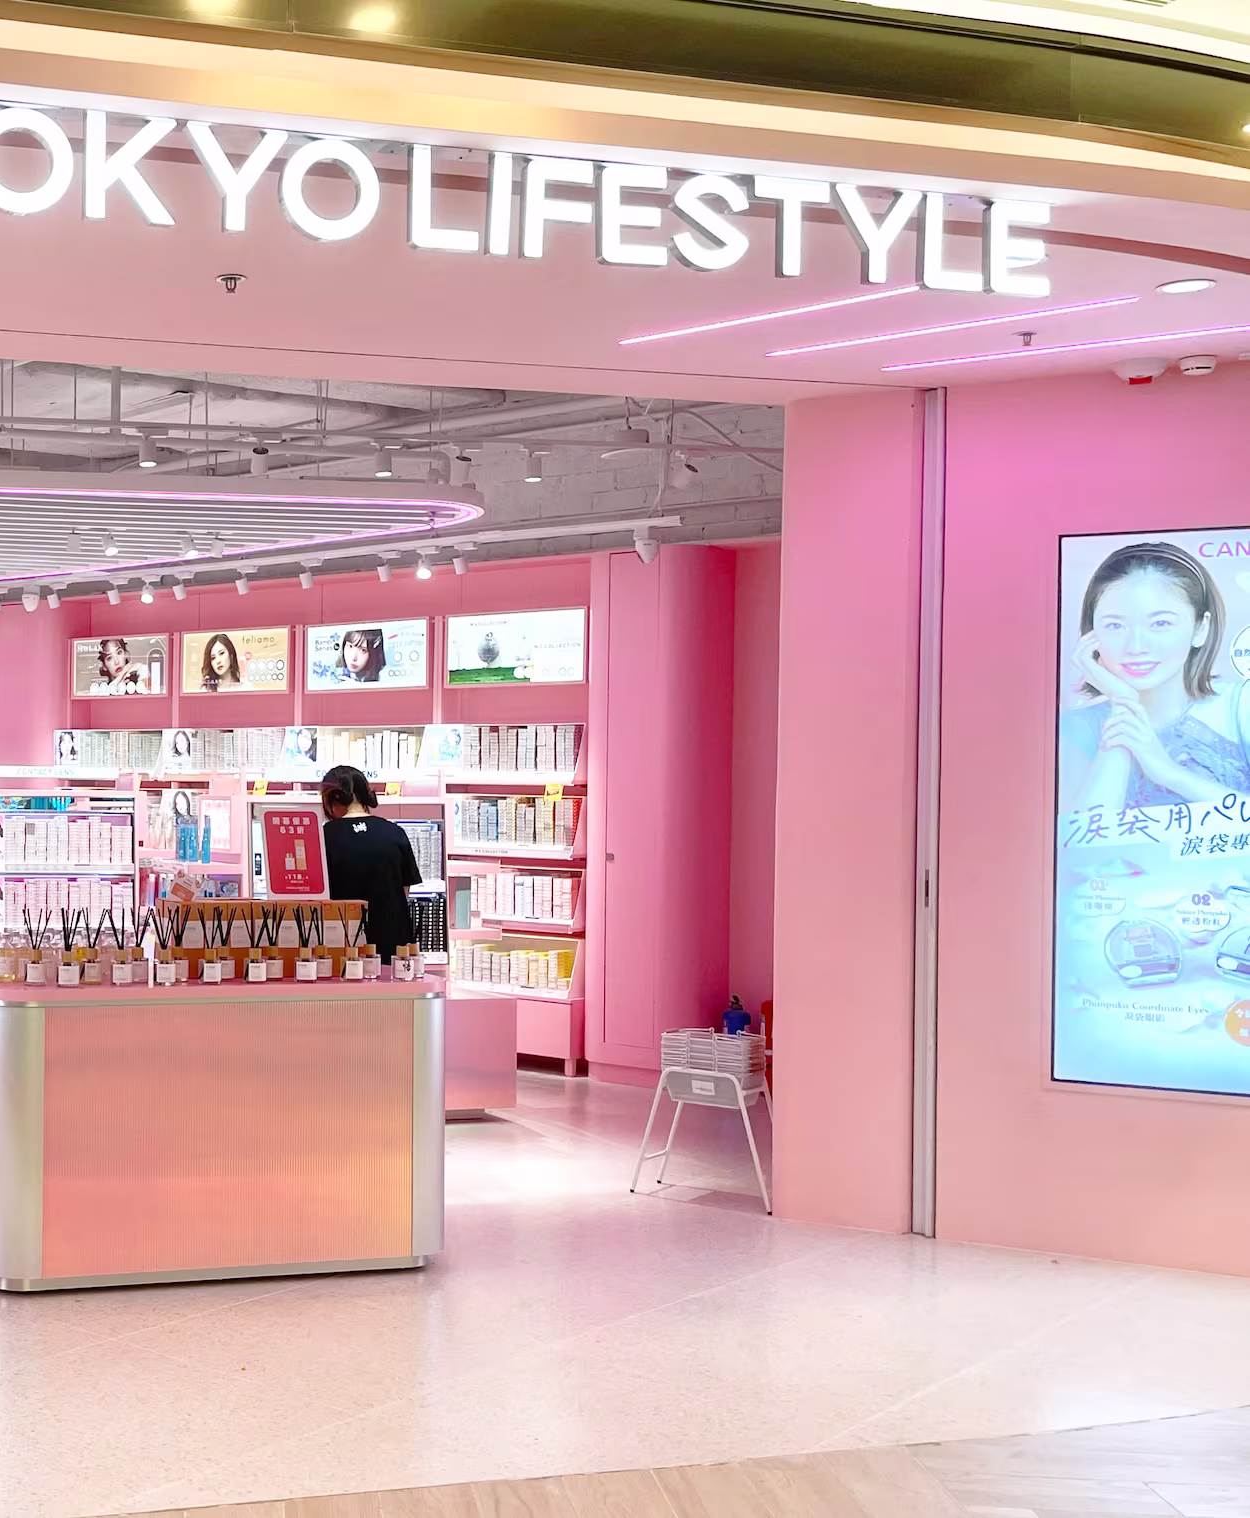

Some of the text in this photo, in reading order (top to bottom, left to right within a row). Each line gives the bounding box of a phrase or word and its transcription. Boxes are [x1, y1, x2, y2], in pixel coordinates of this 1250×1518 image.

[407, 142, 1053, 298] LIFESTYLE
[17, 768, 53, 776] CONTACT
[1191, 894, 1211, 906] 02
